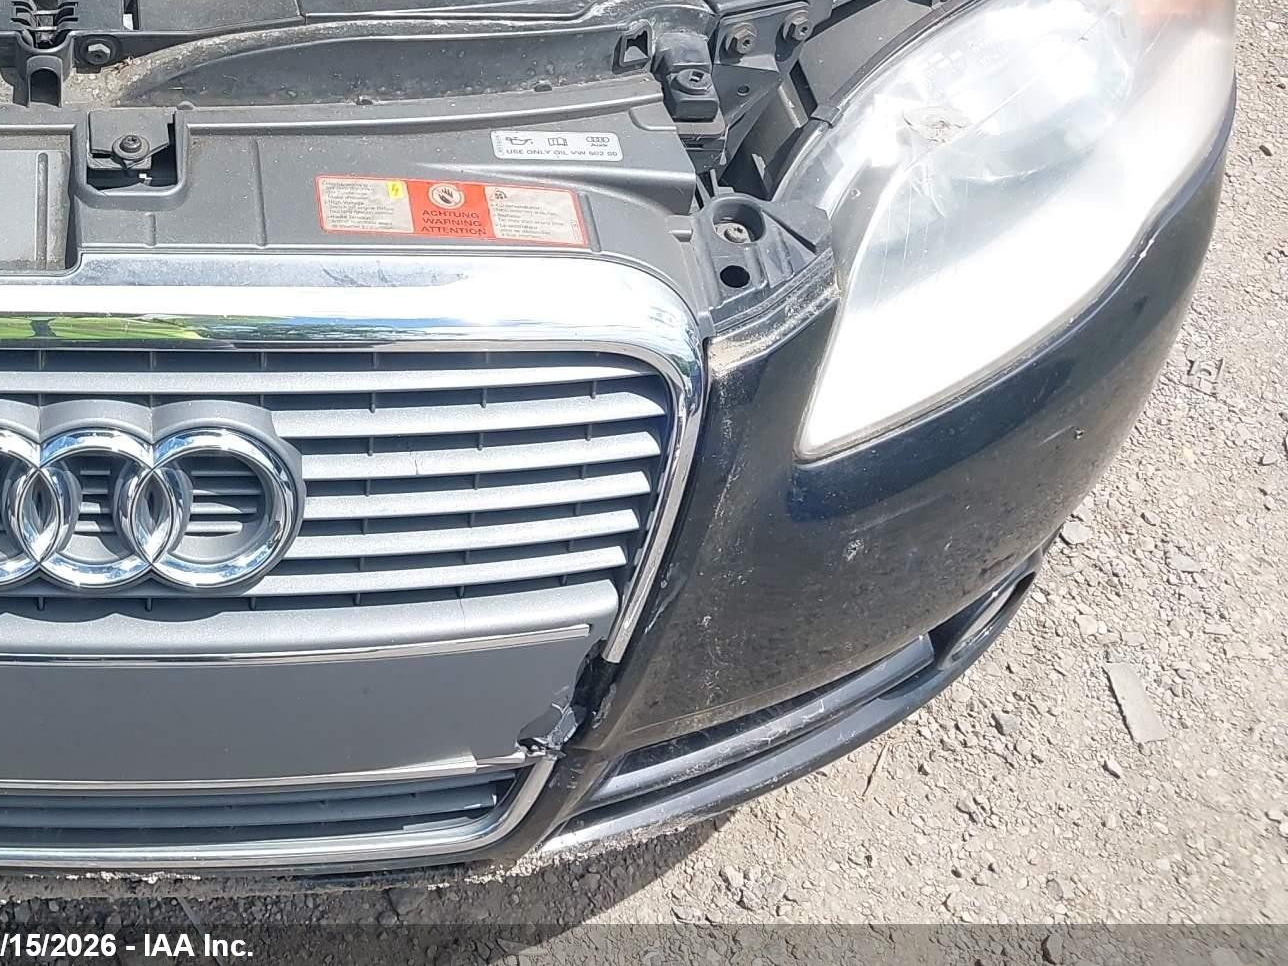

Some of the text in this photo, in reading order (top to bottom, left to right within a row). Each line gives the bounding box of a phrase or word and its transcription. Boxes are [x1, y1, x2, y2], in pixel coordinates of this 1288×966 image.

[422, 210, 479, 219] ACHTUNG
[422, 217, 482, 227] WARNING
[420, 226, 487, 235] ATTENTION
